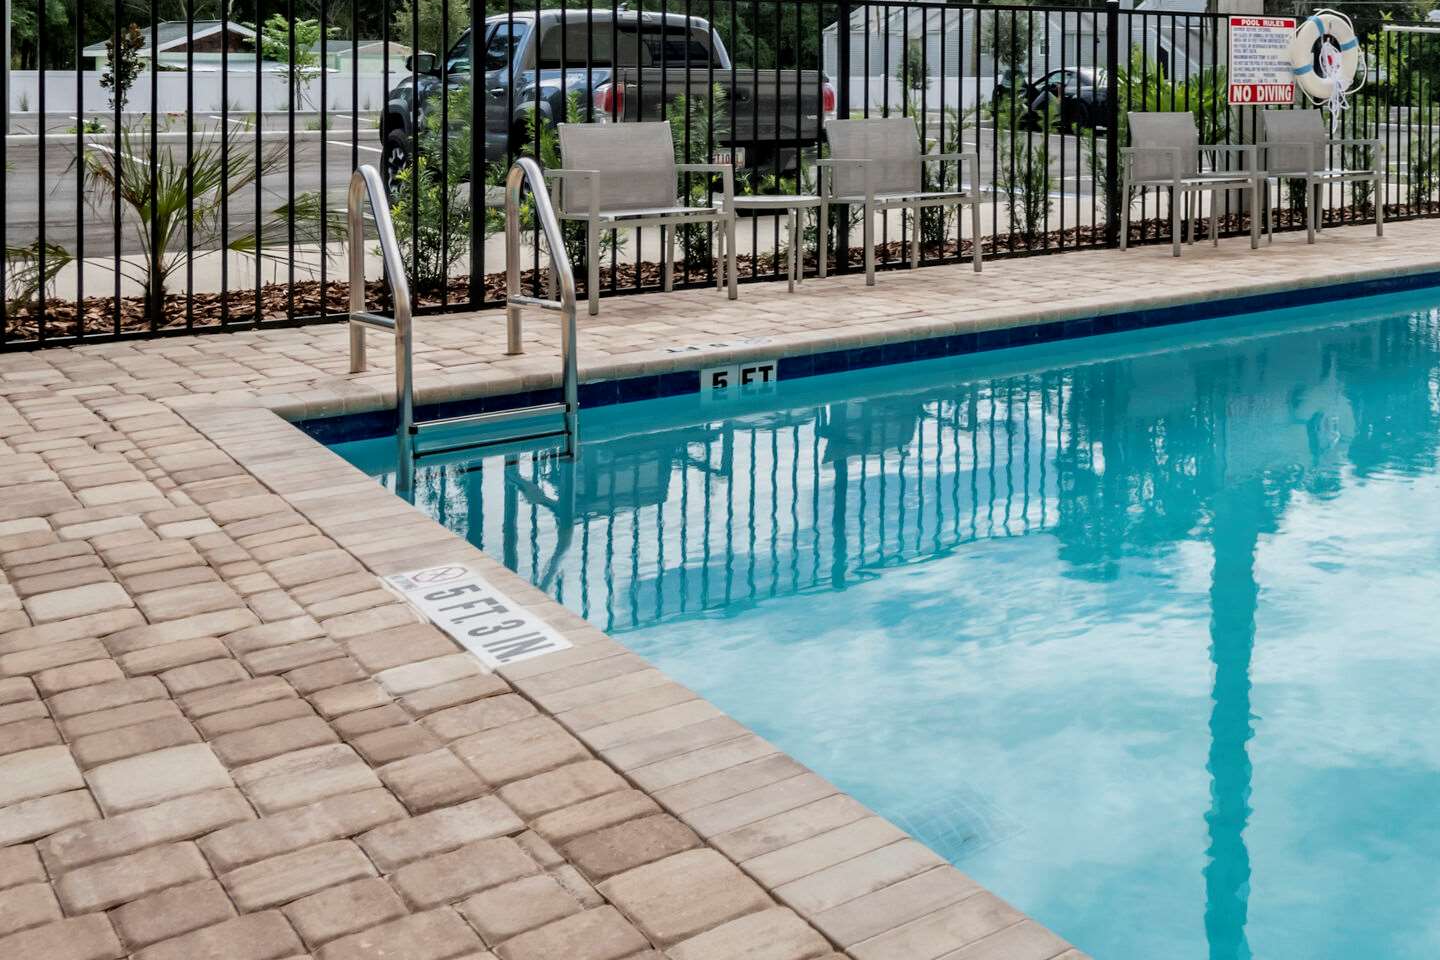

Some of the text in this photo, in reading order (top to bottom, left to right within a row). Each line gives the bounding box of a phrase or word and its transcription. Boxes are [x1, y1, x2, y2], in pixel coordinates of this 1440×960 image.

[1263, 19, 1284, 27] RULES
[1233, 85, 1292, 102] NO DIVING
[712, 365, 774, 390] 5 FT
[424, 584, 482, 601] 5
[467, 618, 526, 638] 3
